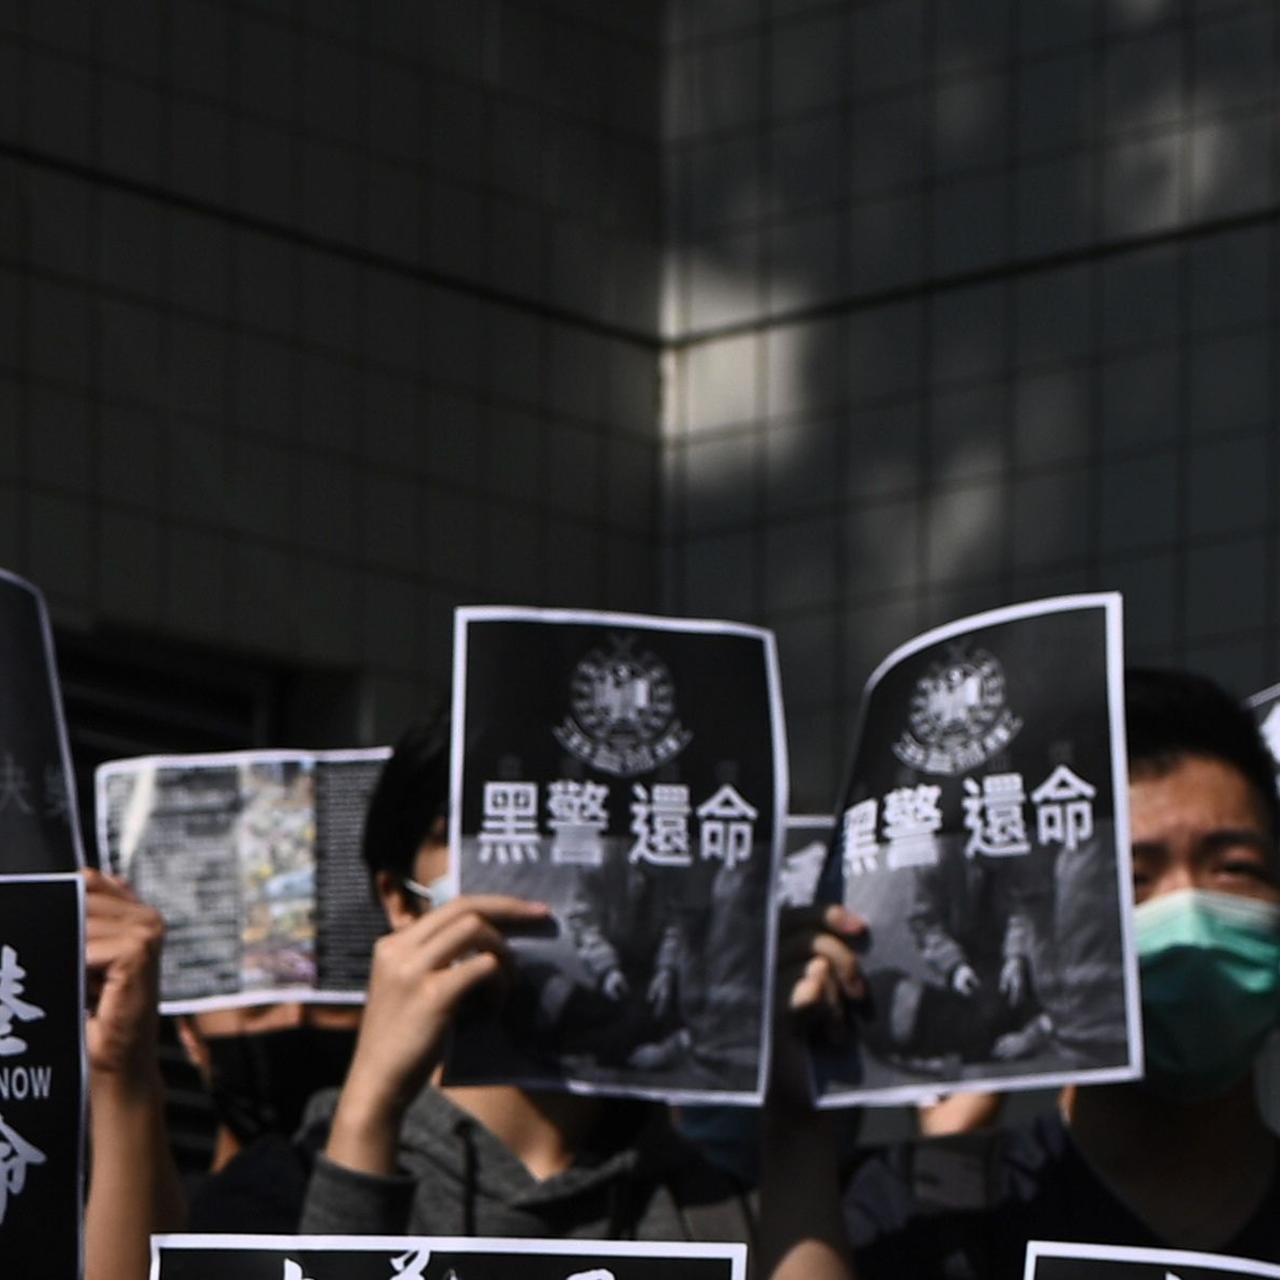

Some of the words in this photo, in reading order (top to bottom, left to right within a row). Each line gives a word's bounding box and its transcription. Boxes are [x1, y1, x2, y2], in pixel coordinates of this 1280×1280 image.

[477, 779, 758, 869] 黑警還命
[842, 763, 1096, 876] 黑警還命
